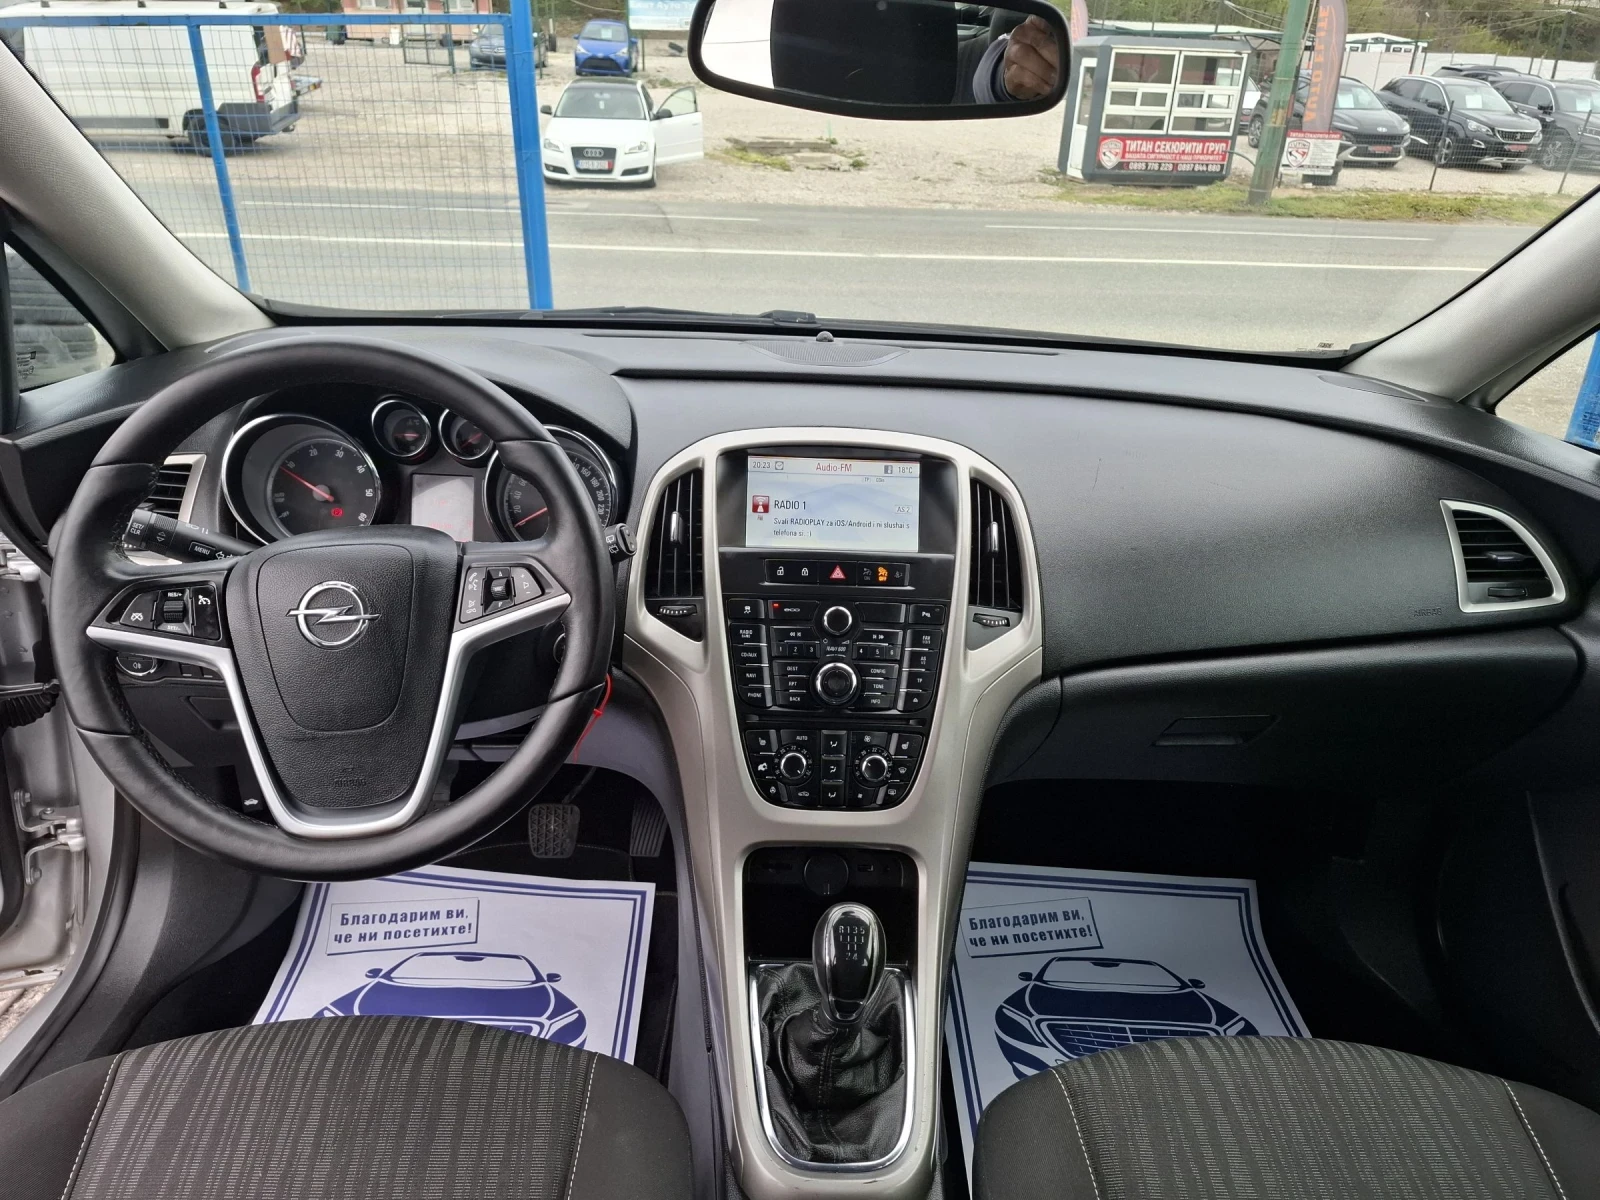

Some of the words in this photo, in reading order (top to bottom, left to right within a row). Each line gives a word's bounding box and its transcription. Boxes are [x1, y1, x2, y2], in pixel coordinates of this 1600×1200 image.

[1125, 140, 1154, 153] ТИТАН
[1154, 141, 1204, 154] СЕКЮРИТИ
[309, 448, 318, 456] 20
[335, 450, 344, 458] 30
[286, 460, 295, 468] 10
[815, 463, 853, 472] Audio-FM
[356, 465, 366, 474] 40
[580, 467, 591, 477] 160
[898, 466, 913, 474] 18°C
[590, 477, 600, 488] 180
[366, 488, 373, 497] 50
[514, 490, 522, 500] 40
[596, 490, 604, 501] 200
[514, 505, 522, 514] 20
[774, 500, 800, 510] RADIO
[802, 501, 806, 510] 1
[358, 513, 367, 522] 60
[132, 522, 144, 530] SET/
[790, 518, 824, 526] RADIOPLAY
[834, 519, 872, 528] iOS/Android
[130, 528, 141, 536] CLR
[194, 546, 210, 555] MENU
[340, 910, 440, 926] Благодарим
[446, 908, 468, 920] ви,
[968, 912, 1058, 930] Благодарим
[1062, 909, 1084, 921] ви,
[334, 932, 352, 944] че
[358, 931, 378, 942] ни
[383, 922, 472, 940] посетихте!
[969, 936, 986, 947] че
[990, 934, 1010, 946] ни
[1012, 924, 1093, 944] посетихте!
